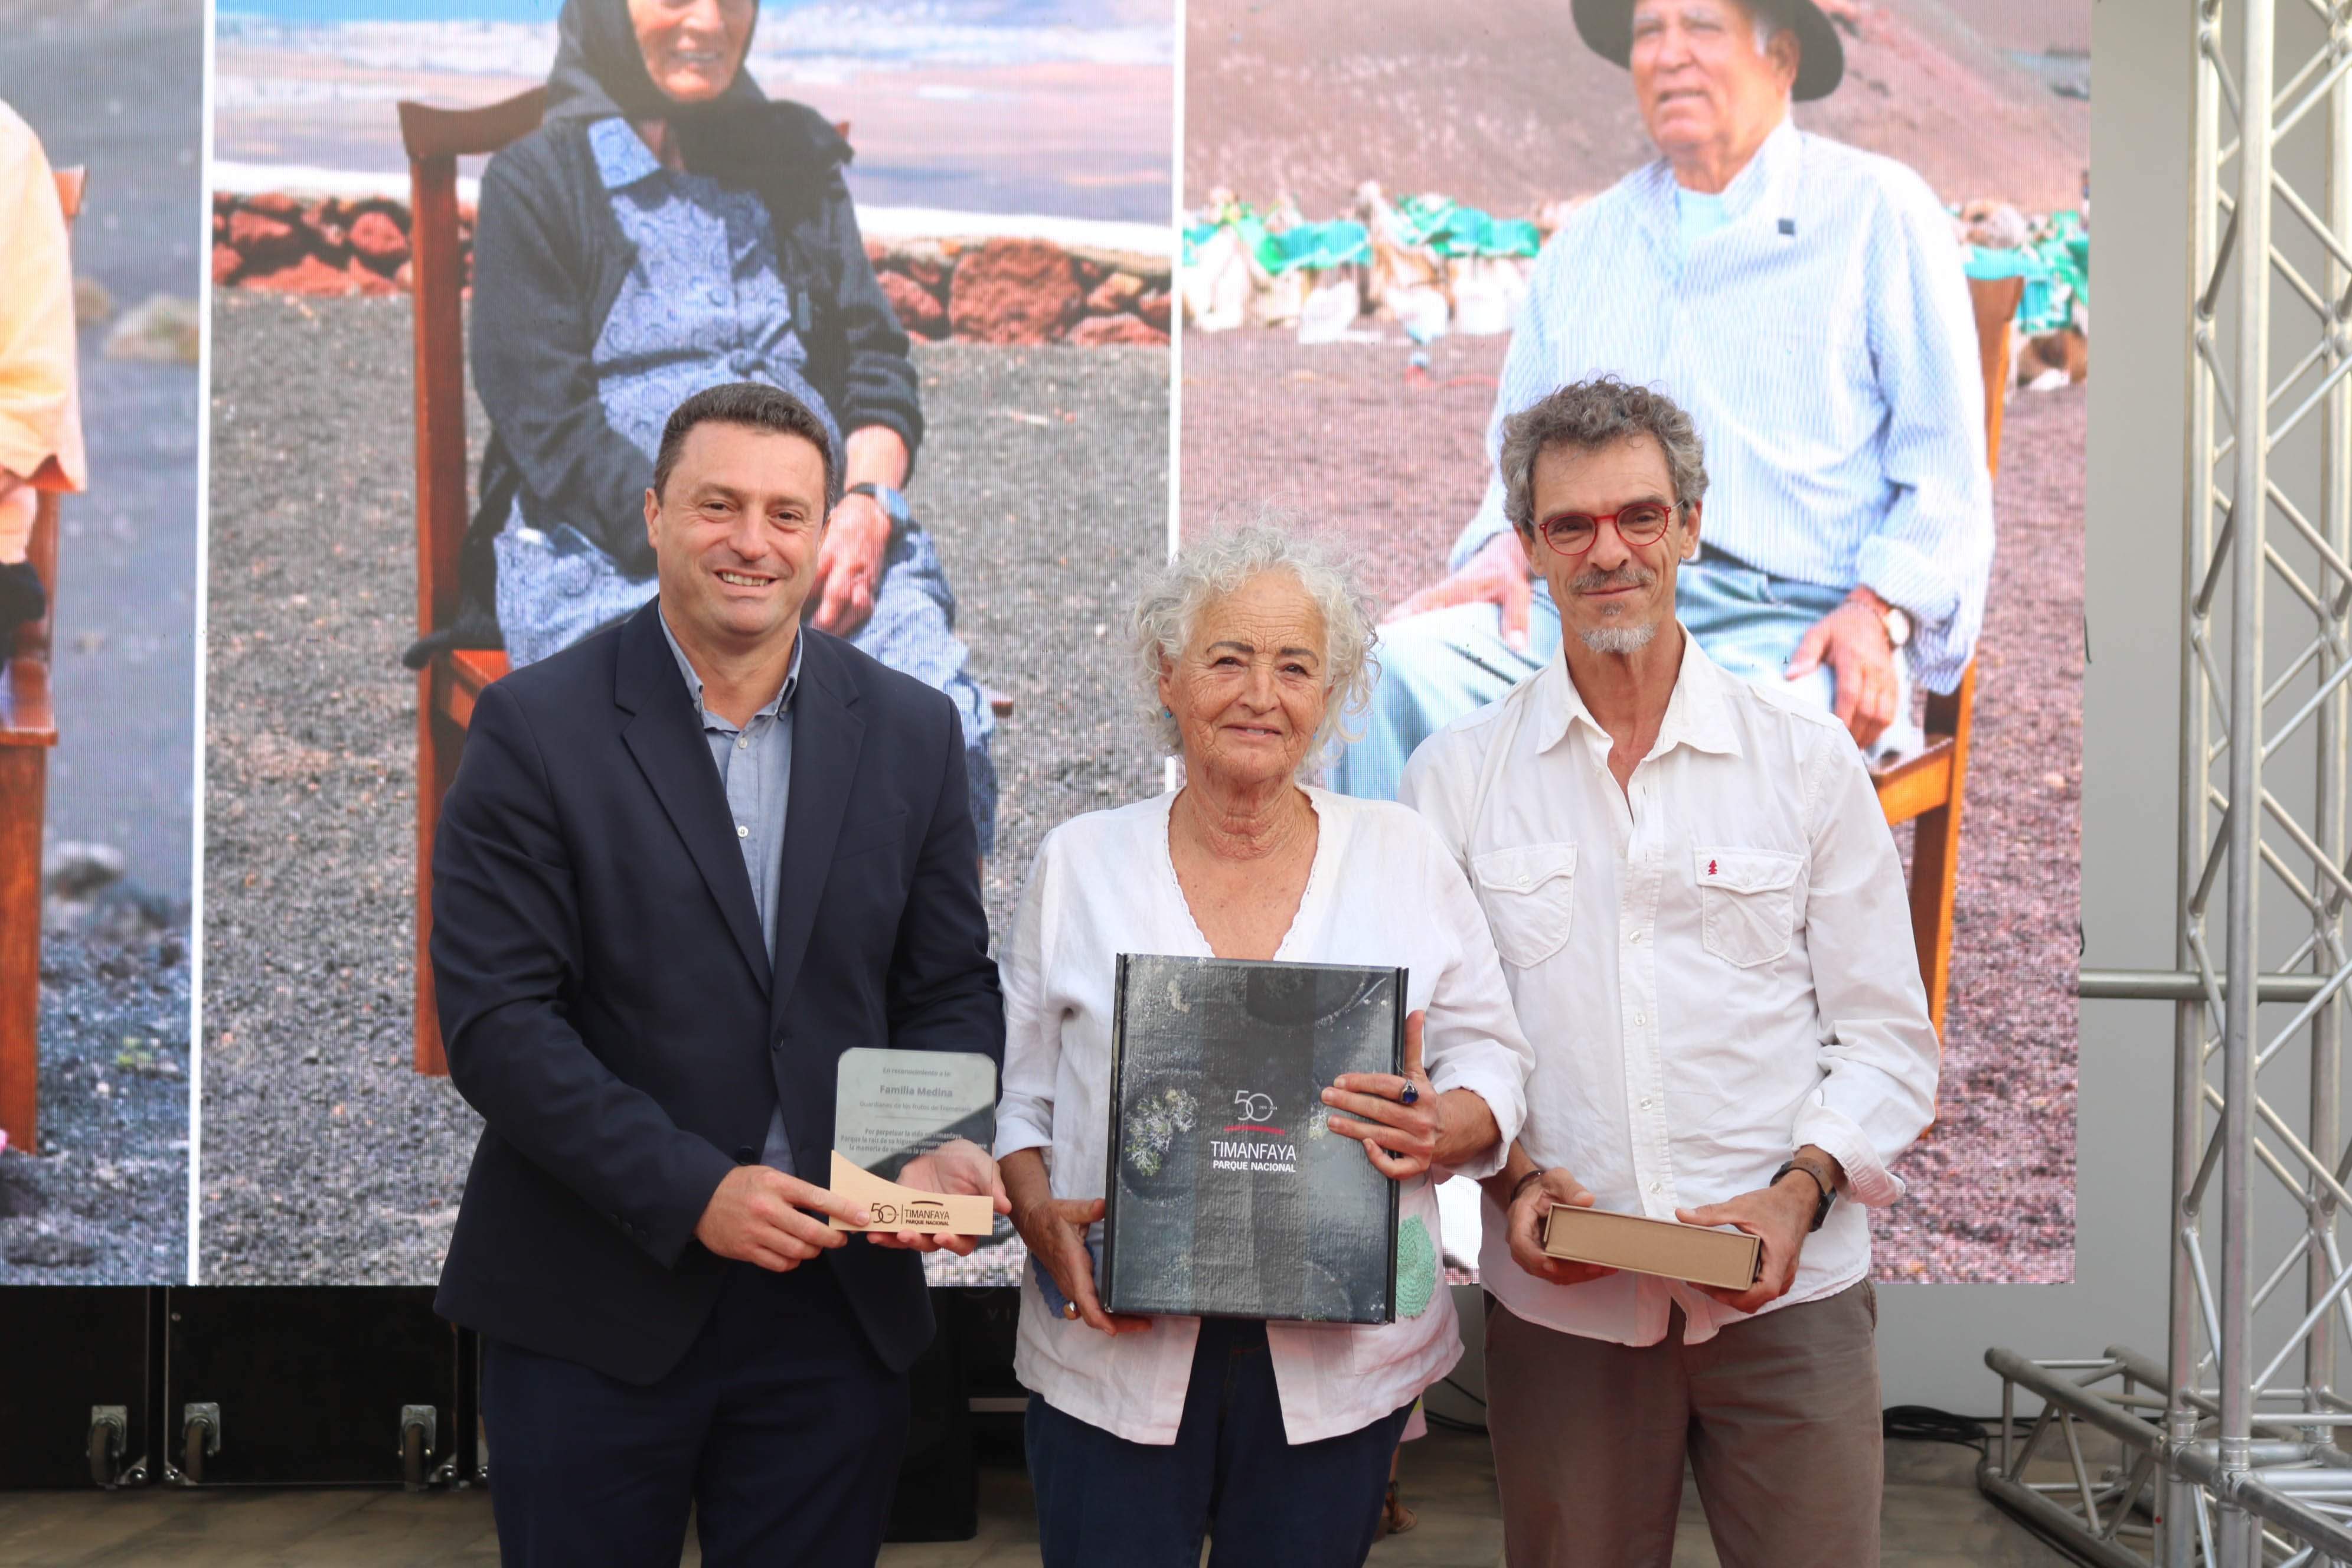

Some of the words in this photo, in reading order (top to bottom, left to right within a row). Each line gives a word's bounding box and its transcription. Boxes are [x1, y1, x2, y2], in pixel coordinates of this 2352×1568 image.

[891, 1067, 938, 1076] reconocimiento
[879, 1084, 915, 1096] Familia
[917, 1086, 953, 1098] Medina
[860, 1100, 893, 1109] Guardianes
[912, 1103, 930, 1111] frutos
[1234, 1090, 1273, 1122] 50
[876, 1128, 904, 1137] perpetuar
[841, 1134, 861, 1144] Porque
[855, 1145, 881, 1153] memoria
[1210, 1141, 1296, 1161] TIMANFAYA
[1213, 1159, 1248, 1171] PARQUE
[1250, 1161, 1296, 1173] NACIONAL
[871, 1202, 897, 1224] 50
[904, 1208, 950, 1220] TIMANFAYA
